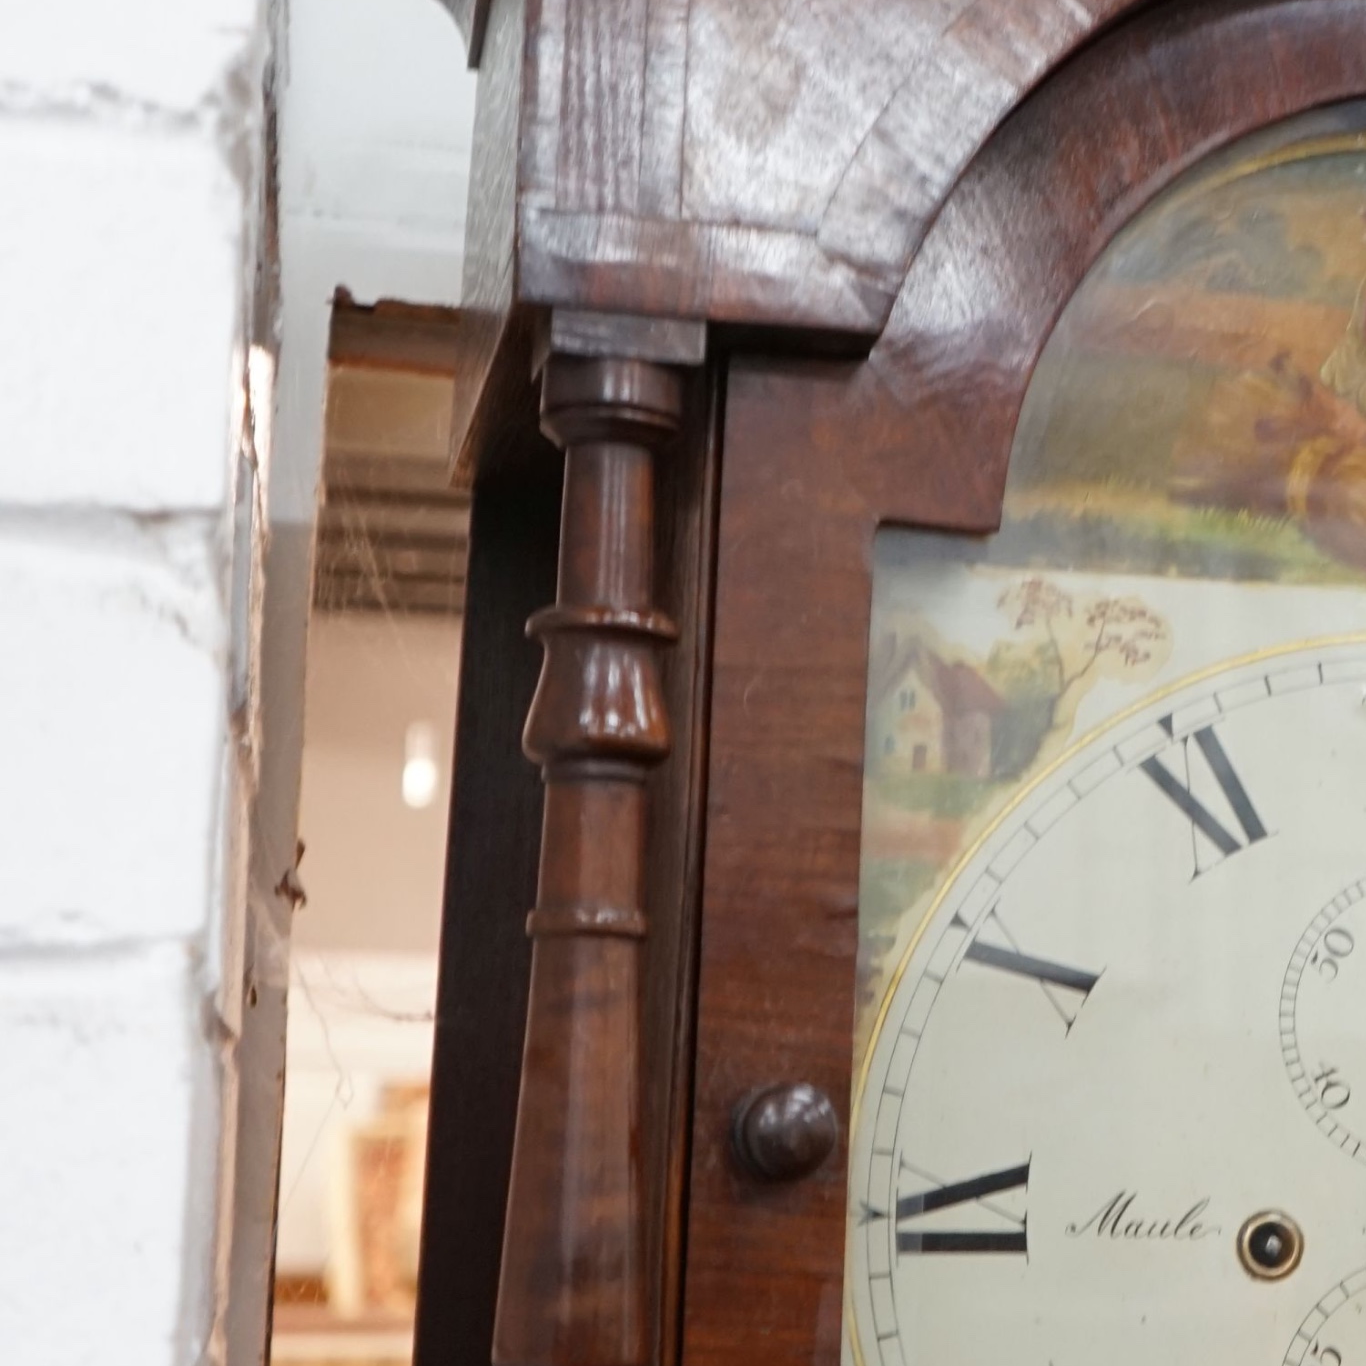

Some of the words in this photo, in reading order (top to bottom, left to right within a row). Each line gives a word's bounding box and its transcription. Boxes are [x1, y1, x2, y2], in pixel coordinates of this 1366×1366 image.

[1138, 720, 1273, 880] XI
[961, 909, 1107, 1037] X
[1311, 926, 1354, 982] 50
[1311, 1060, 1351, 1110] 40
[896, 1153, 1031, 1256] IX
[1065, 1189, 1223, 1241] Maule
